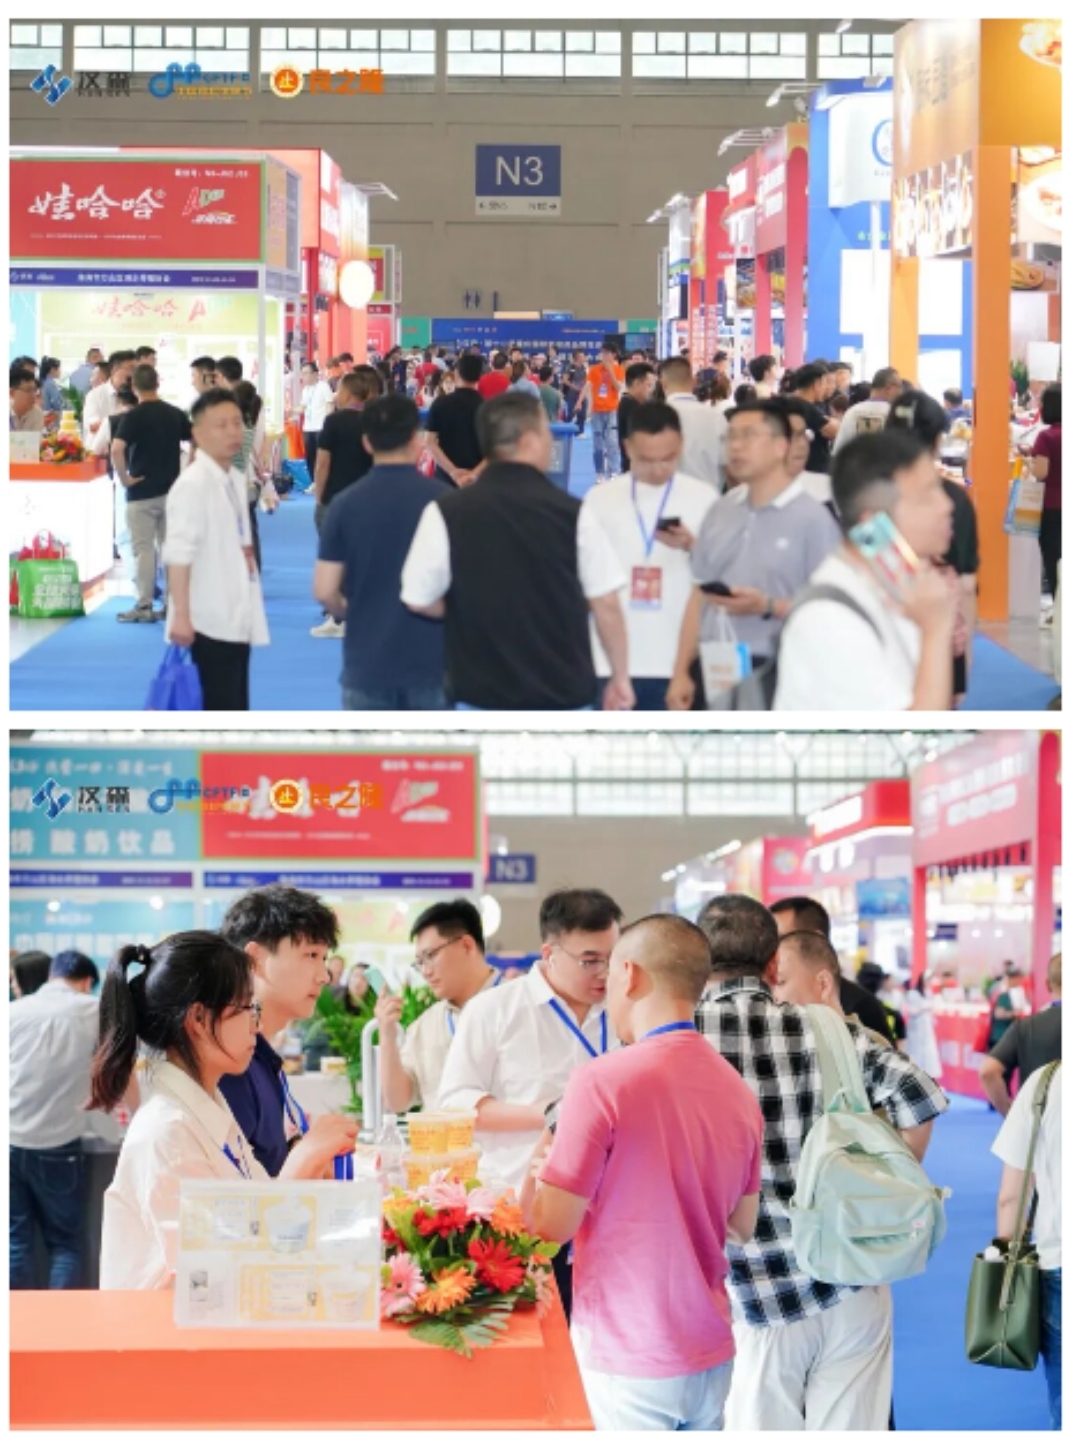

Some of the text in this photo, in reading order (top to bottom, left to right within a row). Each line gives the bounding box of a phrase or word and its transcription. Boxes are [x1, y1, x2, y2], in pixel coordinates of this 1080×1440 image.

[495, 155, 544, 186] N3
[27, 181, 165, 220] 娃哈哈
[495, 859, 528, 881] N3
